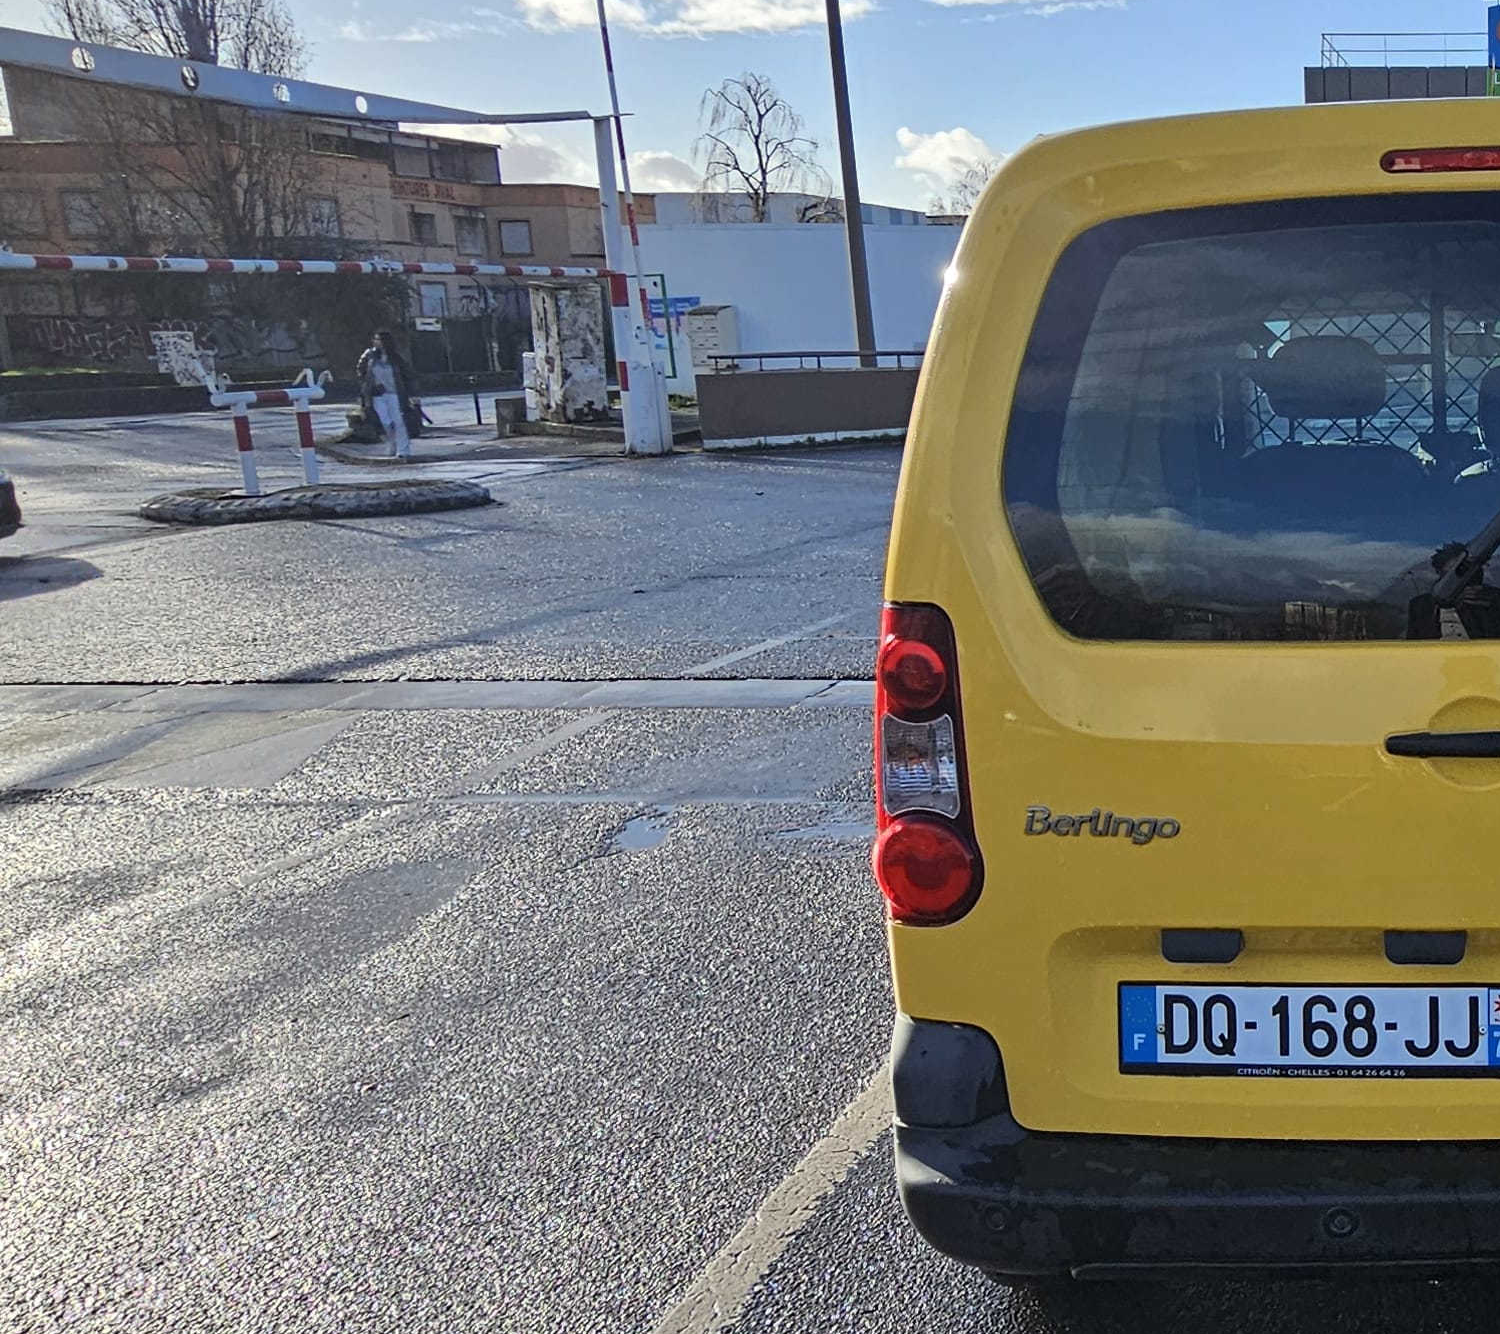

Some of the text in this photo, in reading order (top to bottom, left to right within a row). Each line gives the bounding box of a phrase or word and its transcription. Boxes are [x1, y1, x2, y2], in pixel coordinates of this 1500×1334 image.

[1024, 805, 1181, 845] Berlingo
[1133, 1033, 1147, 1051] F
[1164, 993, 1480, 1059] DQ-168-JJ
[1237, 1067, 1280, 1076] CITROËN
[1287, 1068, 1330, 1077] CHELLES
[1336, 1069, 1348, 1077] 01
[1351, 1069, 1363, 1077] 64
[1365, 1069, 1378, 1077] 26
[1380, 1069, 1392, 1077] 64
[1393, 1069, 1406, 1077] 26
